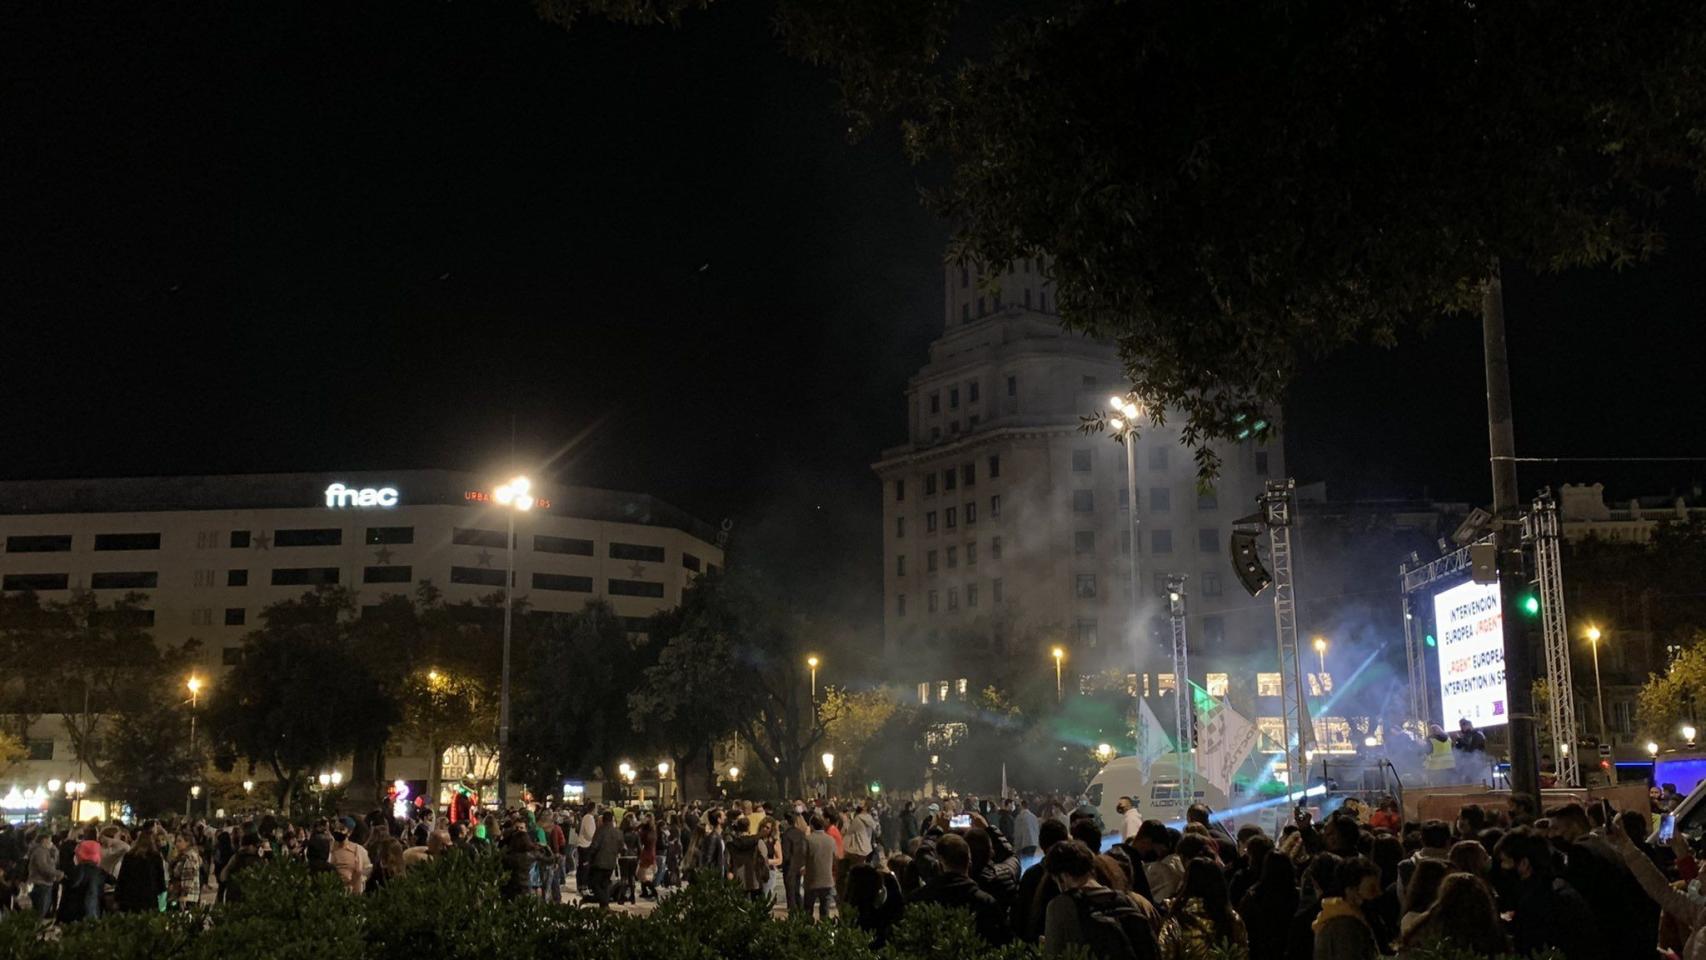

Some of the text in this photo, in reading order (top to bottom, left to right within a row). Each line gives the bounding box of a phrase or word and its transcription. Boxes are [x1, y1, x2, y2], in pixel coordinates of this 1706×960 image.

[325, 483, 398, 507] fnac
[1445, 624, 1473, 645] EUROPEA
[1443, 673, 1487, 696] INTERVENTION
